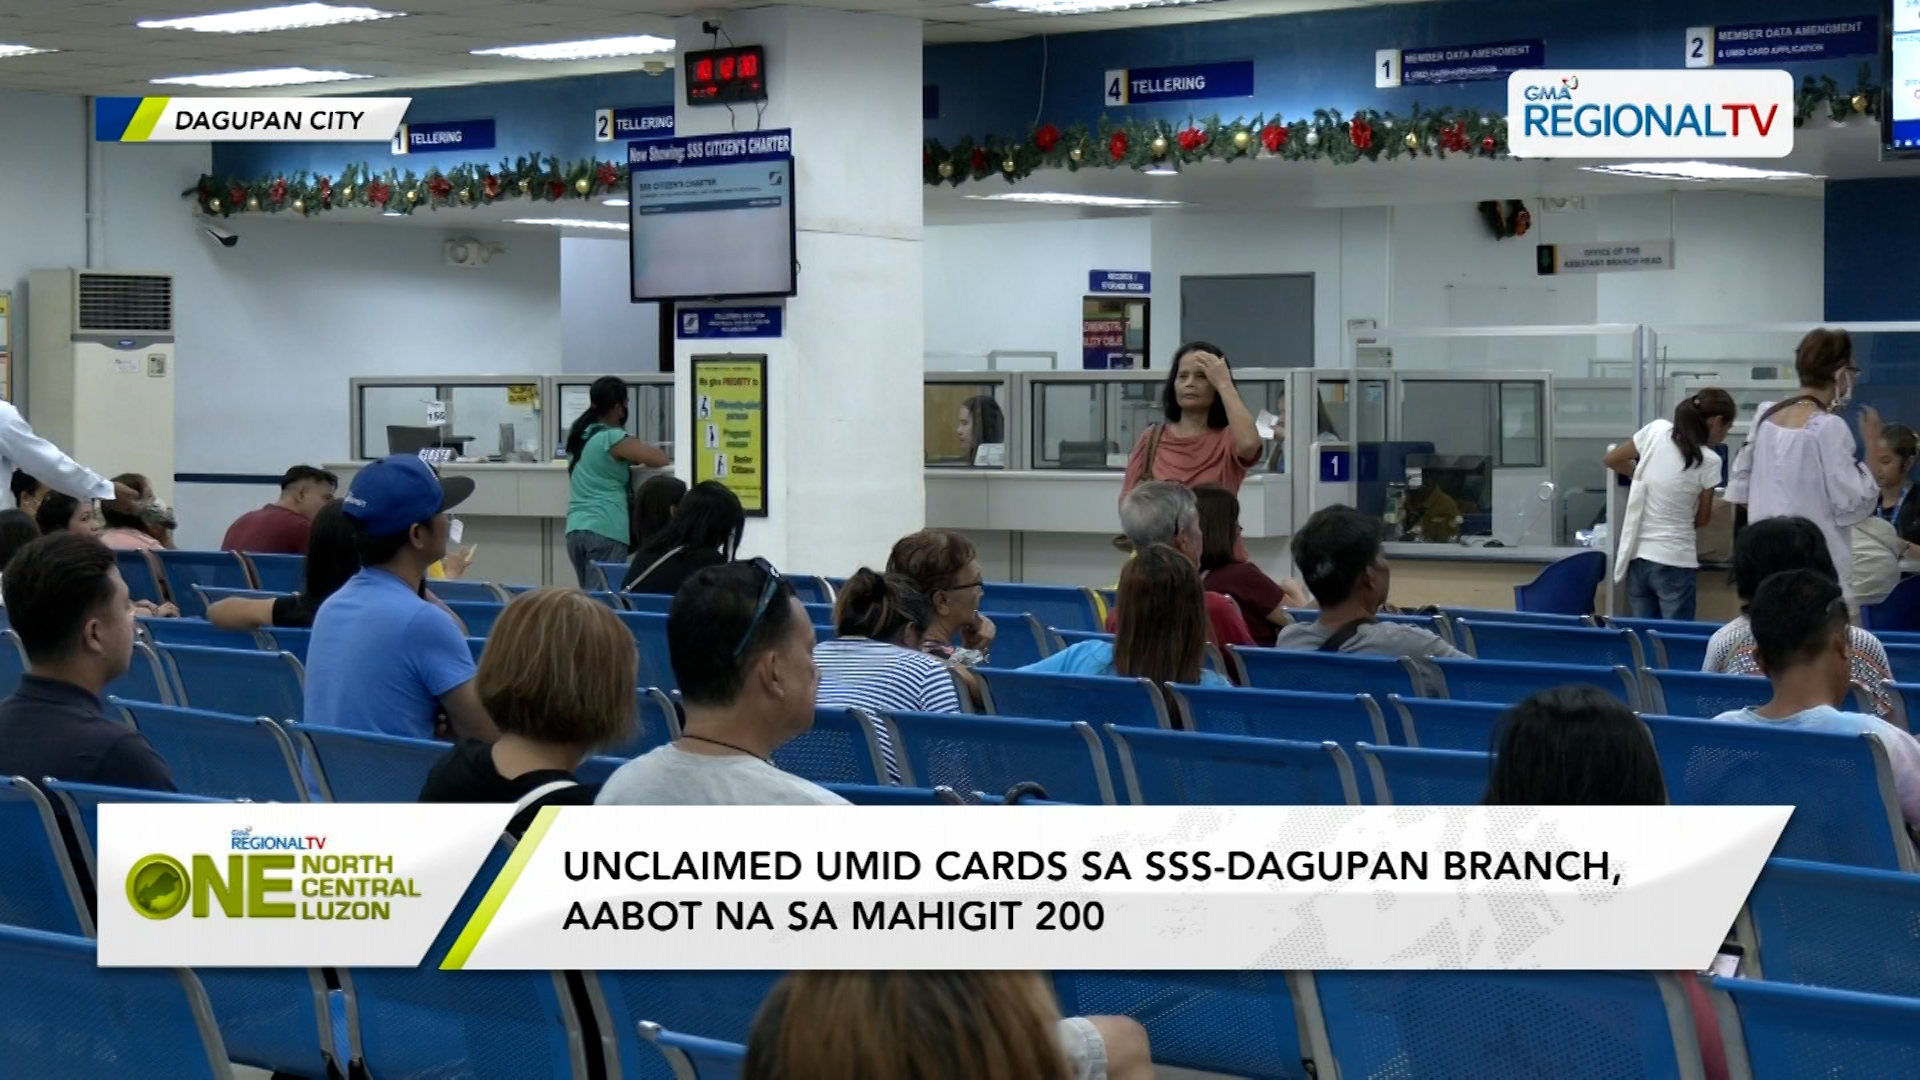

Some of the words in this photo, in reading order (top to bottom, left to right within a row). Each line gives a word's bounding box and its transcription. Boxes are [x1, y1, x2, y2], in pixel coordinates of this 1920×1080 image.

[1690, 37, 1704, 58] 2
[1718, 28, 1763, 41] MEMBER
[1765, 25, 1793, 38] DATA
[1794, 21, 1863, 36] AMENDMENT
[1382, 60, 1391, 79] 1
[1405, 53, 1444, 64] MEMBER
[1446, 50, 1470, 61] DATA
[1471, 45, 1530, 58] AMENDMENT
[1108, 78, 1121, 102] 4
[1131, 75, 1206, 94] TELLERING
[410, 131, 463, 145] TELLERING
[598, 115, 609, 138] 2
[616, 116, 674, 131] TELLERING
[686, 141, 704, 158] SSS
[748, 135, 790, 152] CHARTER
[1331, 455, 1339, 476] 1
